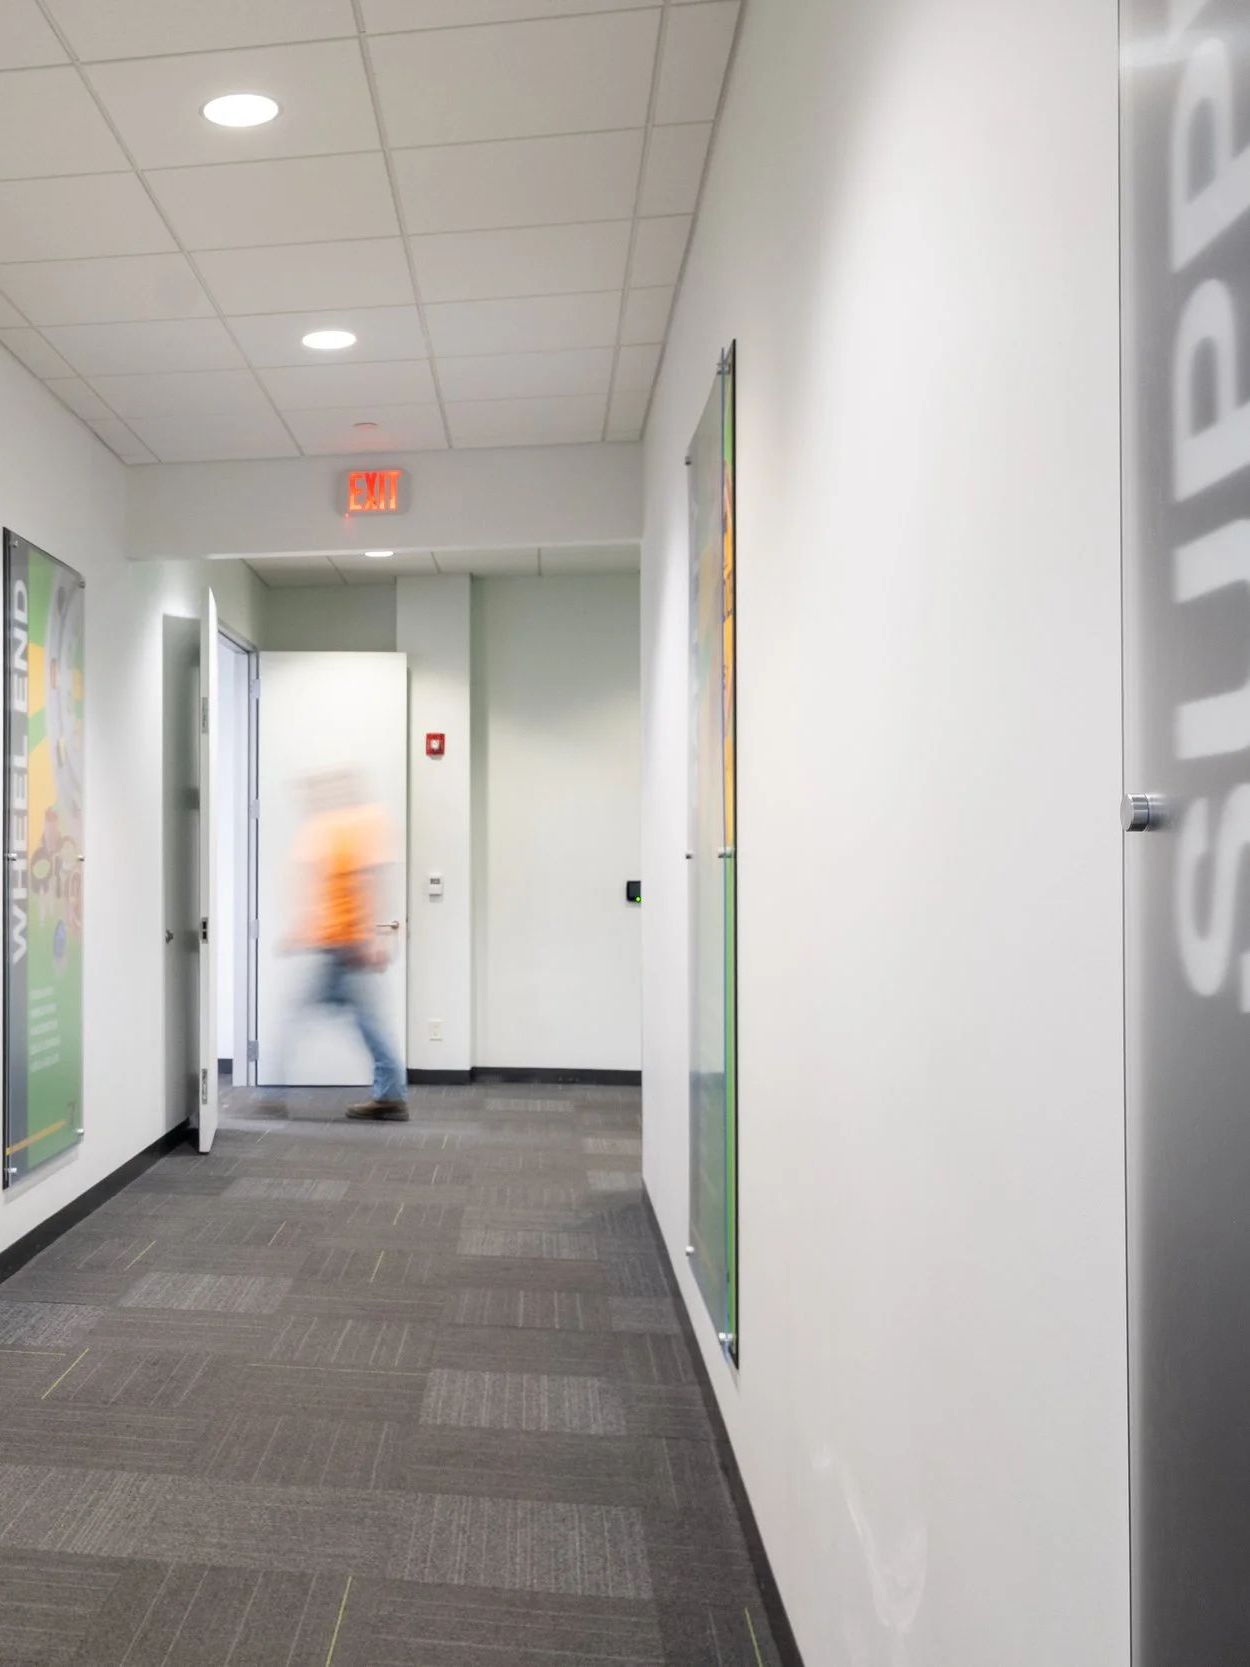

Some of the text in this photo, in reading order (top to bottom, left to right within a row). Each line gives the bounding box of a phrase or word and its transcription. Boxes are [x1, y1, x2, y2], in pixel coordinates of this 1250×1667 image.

[349, 469, 401, 511] EXIT
[1167, 0, 1250, 1014] SUPP
[12, 579, 28, 965] WHEEL END
